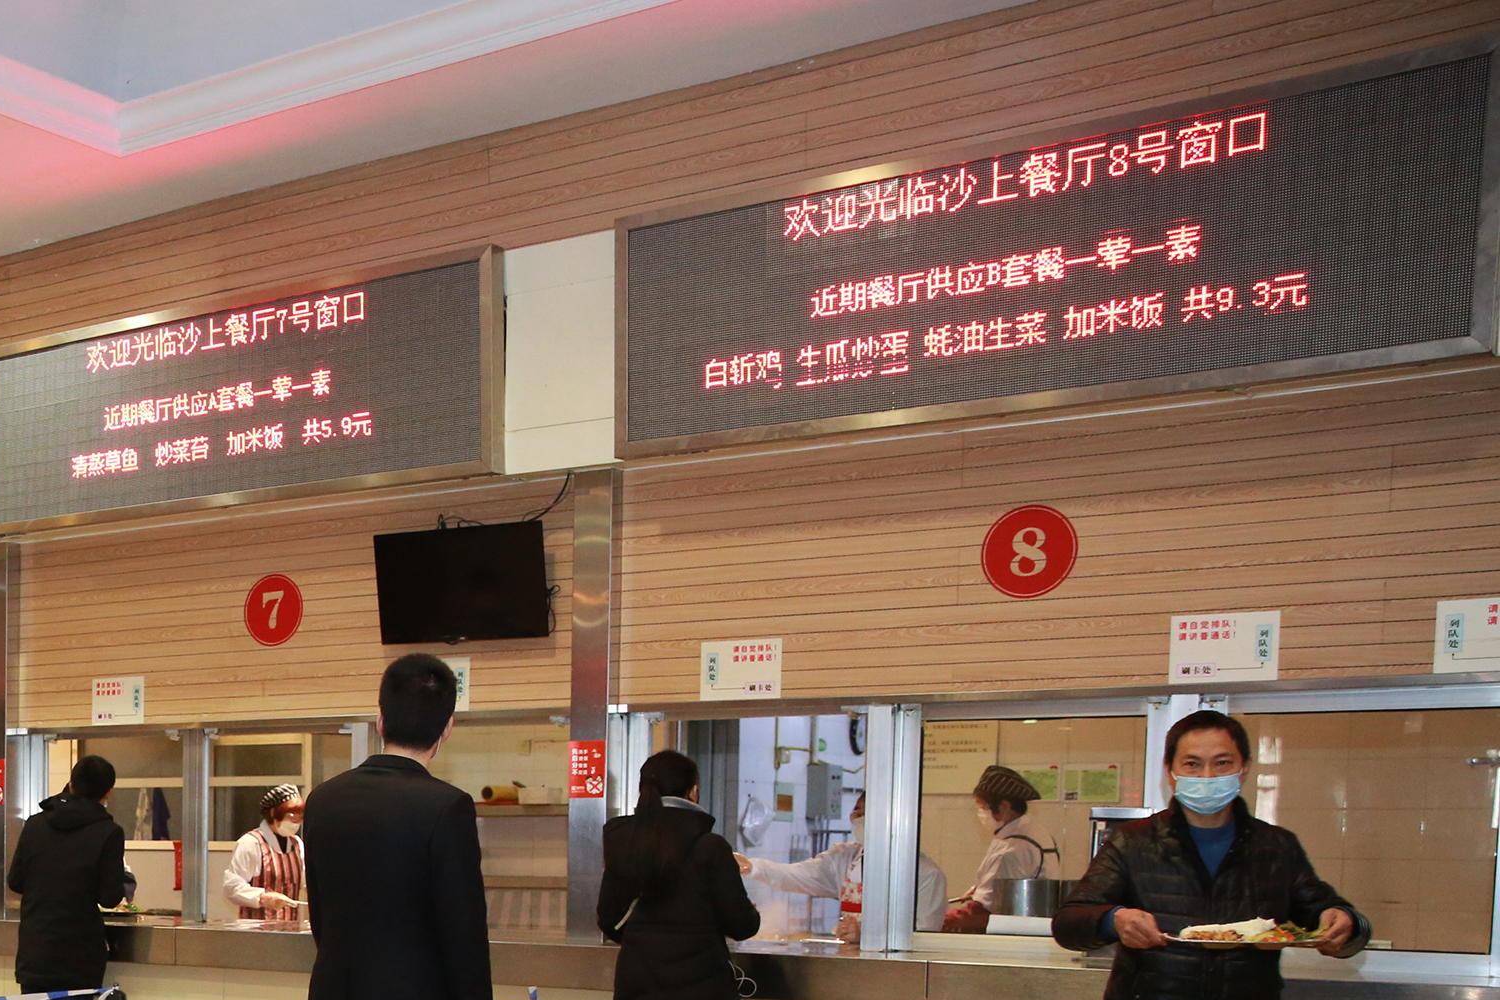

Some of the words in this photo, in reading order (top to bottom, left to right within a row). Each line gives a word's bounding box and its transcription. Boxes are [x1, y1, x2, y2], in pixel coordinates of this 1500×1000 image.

[784, 112, 1267, 241] 欢迎光临沙上餐厅8号窗口
[810, 224, 1202, 319] 近期餐厅供应B套餐一荤一素
[85, 291, 365, 374] 欢迎光临沙上餐厅7号窗口
[704, 349, 783, 390] 白斩鸡
[923, 311, 1048, 358] 蚝油生菜
[1062, 291, 1164, 340] 加米饭
[1180, 272, 1308, 323] 共9.3元
[103, 368, 331, 432] 近期餐厅供应A套餐一荤一素
[71, 446, 139, 479] 清蒸草鱼
[154, 435, 210, 467] 炒菜苔
[226, 422, 284, 457] 加米饭
[301, 411, 372, 446] 共5.9元
[1010, 527, 1047, 577] 8
[262, 590, 284, 629] 7
